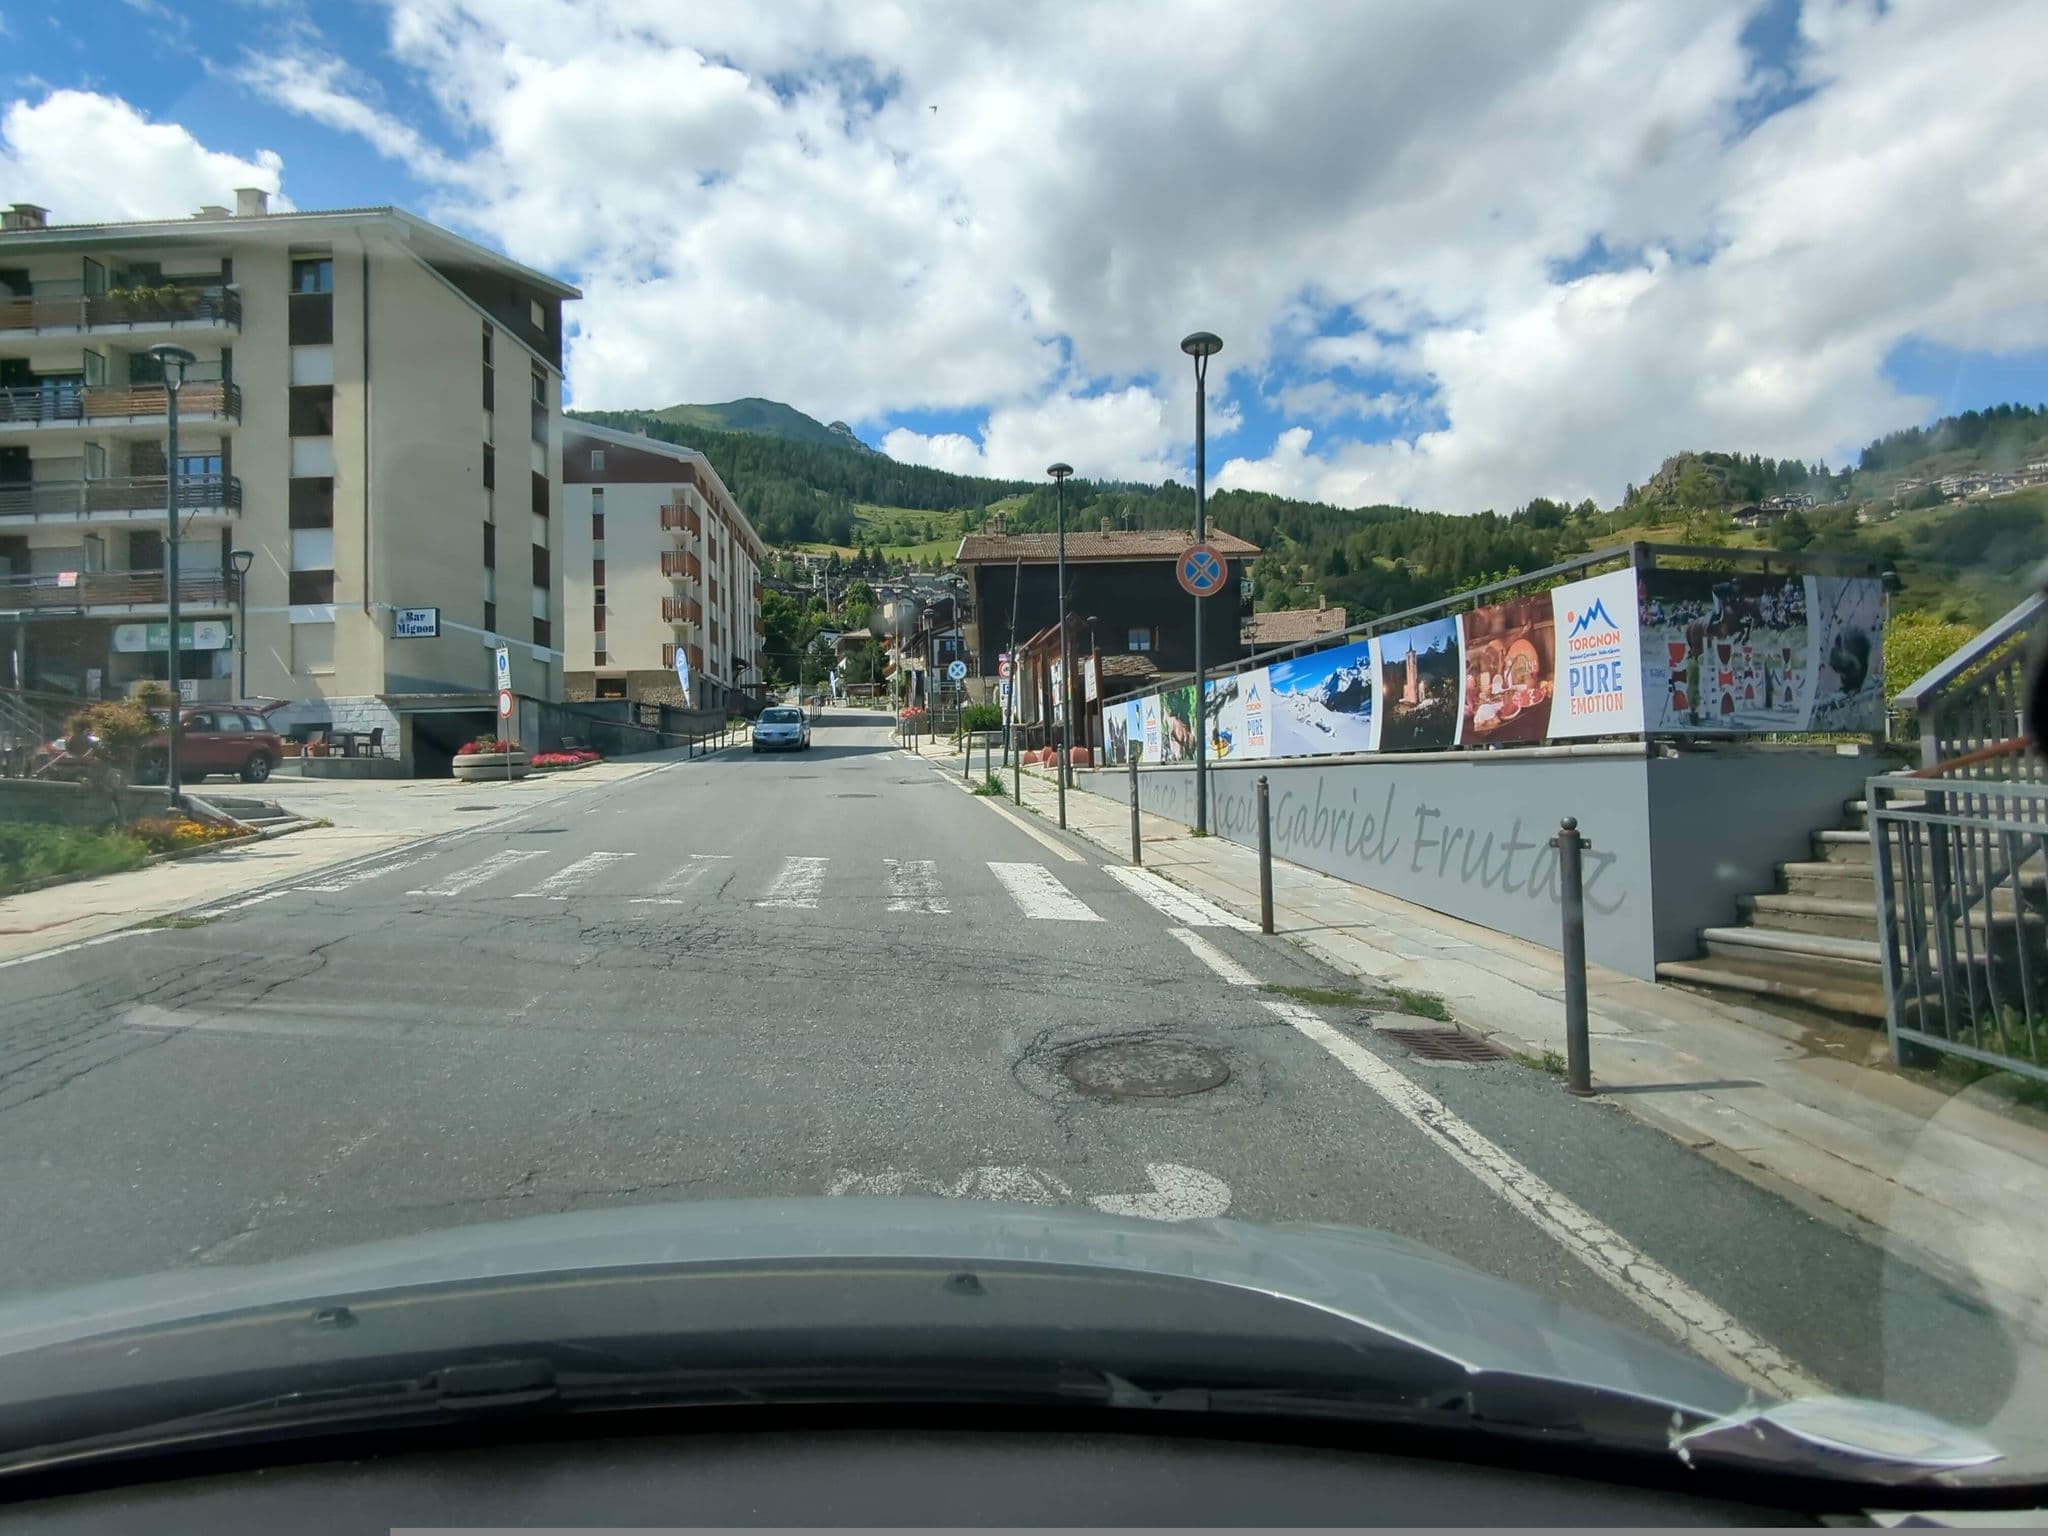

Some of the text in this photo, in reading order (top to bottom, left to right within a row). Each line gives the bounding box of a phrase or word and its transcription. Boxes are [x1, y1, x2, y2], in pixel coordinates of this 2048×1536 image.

[406, 611, 425, 621] Bar
[398, 623, 434, 634] Mignon
[1568, 631, 1621, 651] TORGNON
[1570, 661, 1622, 696] PURE
[1571, 693, 1623, 715] EMOTION
[1409, 803, 1628, 915] Frutaz
